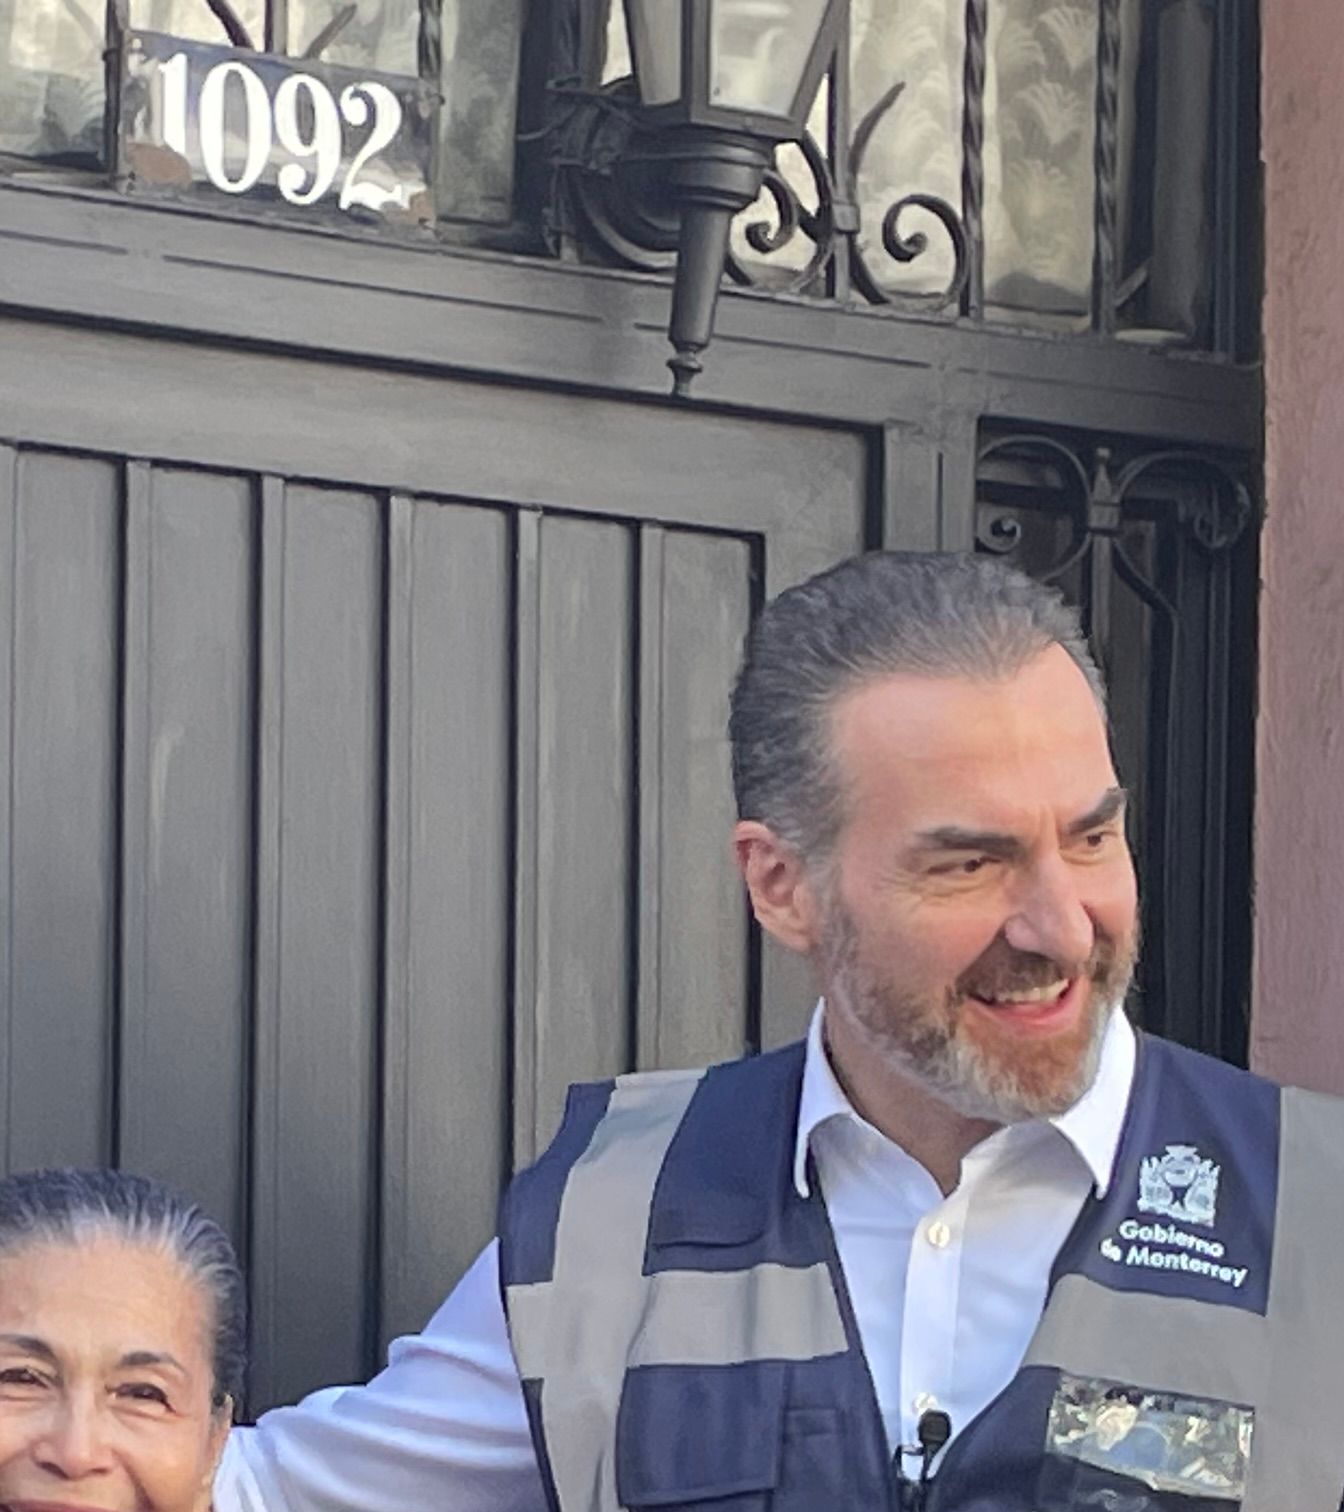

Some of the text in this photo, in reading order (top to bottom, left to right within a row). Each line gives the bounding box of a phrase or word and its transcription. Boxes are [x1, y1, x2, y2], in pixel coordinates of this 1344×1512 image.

[158, 52, 408, 210] 1092
[1119, 1220, 1224, 1257] Gobierno
[1126, 1244, 1248, 1287] Monterrey
